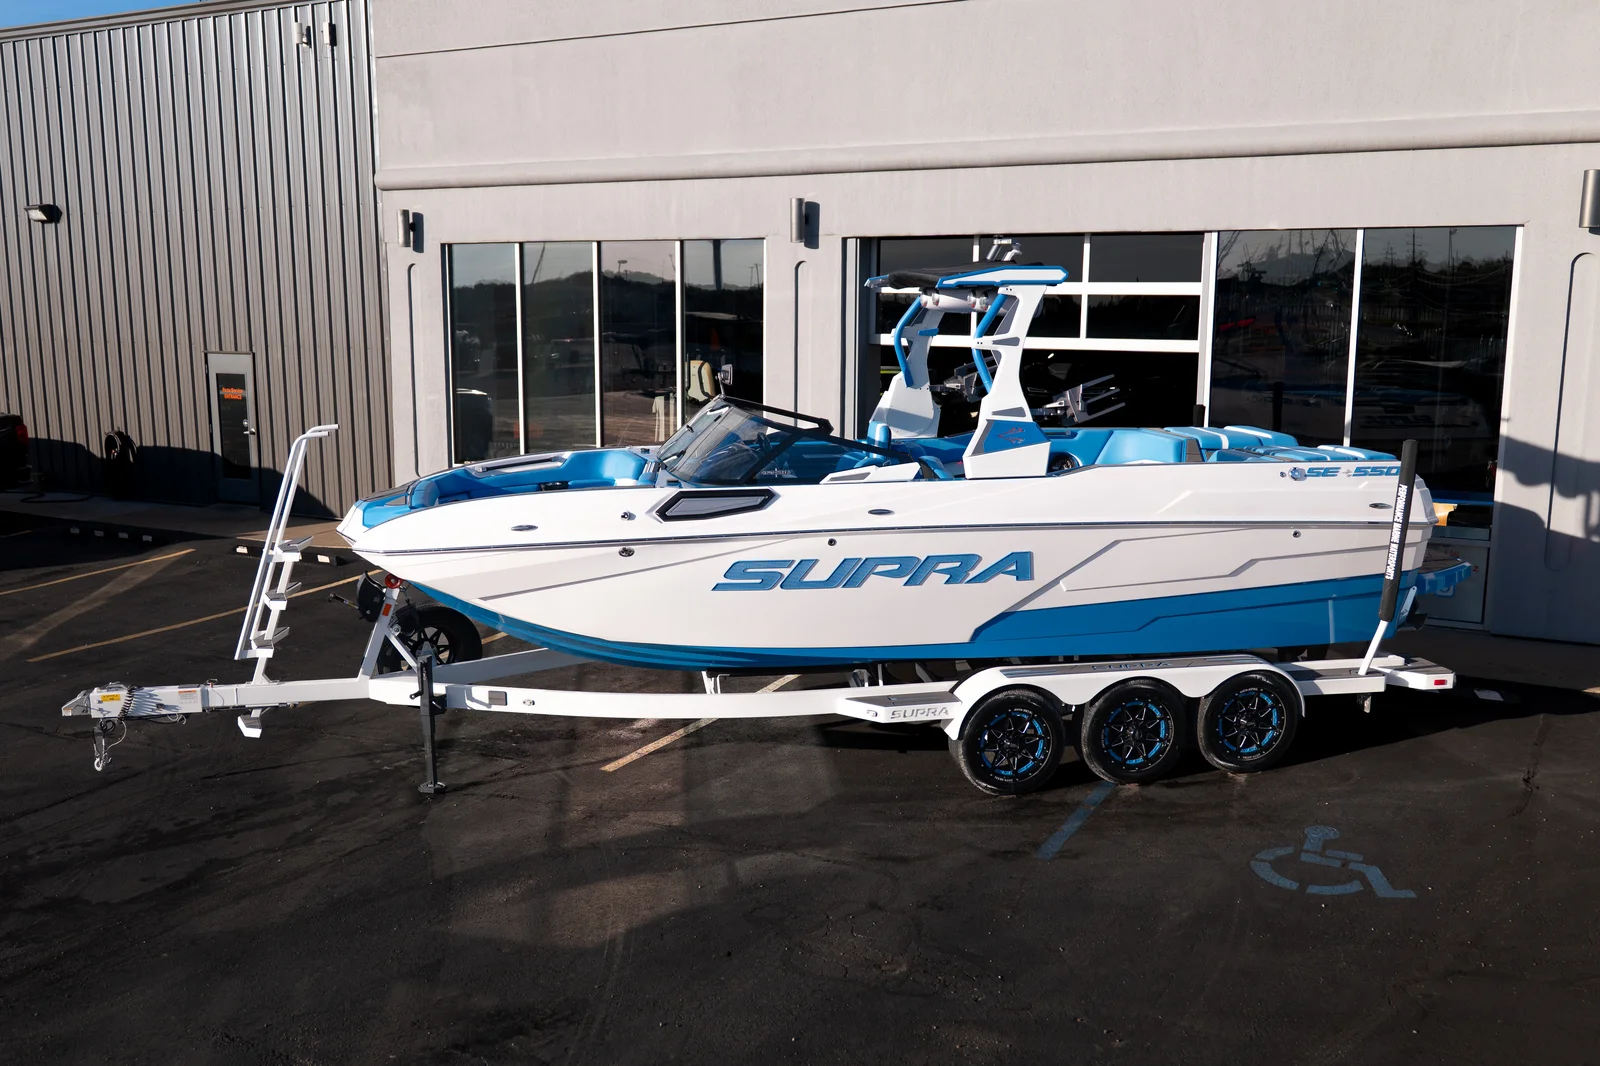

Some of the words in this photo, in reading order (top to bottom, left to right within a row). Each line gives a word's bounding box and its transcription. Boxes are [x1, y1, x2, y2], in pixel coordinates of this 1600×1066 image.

[1306, 466, 1341, 478] SE
[1352, 465, 1400, 477] 550
[1393, 483, 1408, 523] PERFORMANCE
[1390, 522, 1402, 543] MARINE
[711, 550, 1035, 592] SUPRA
[1384, 542, 1399, 580] WATERSPORTS
[890, 706, 949, 719] SUPRA
